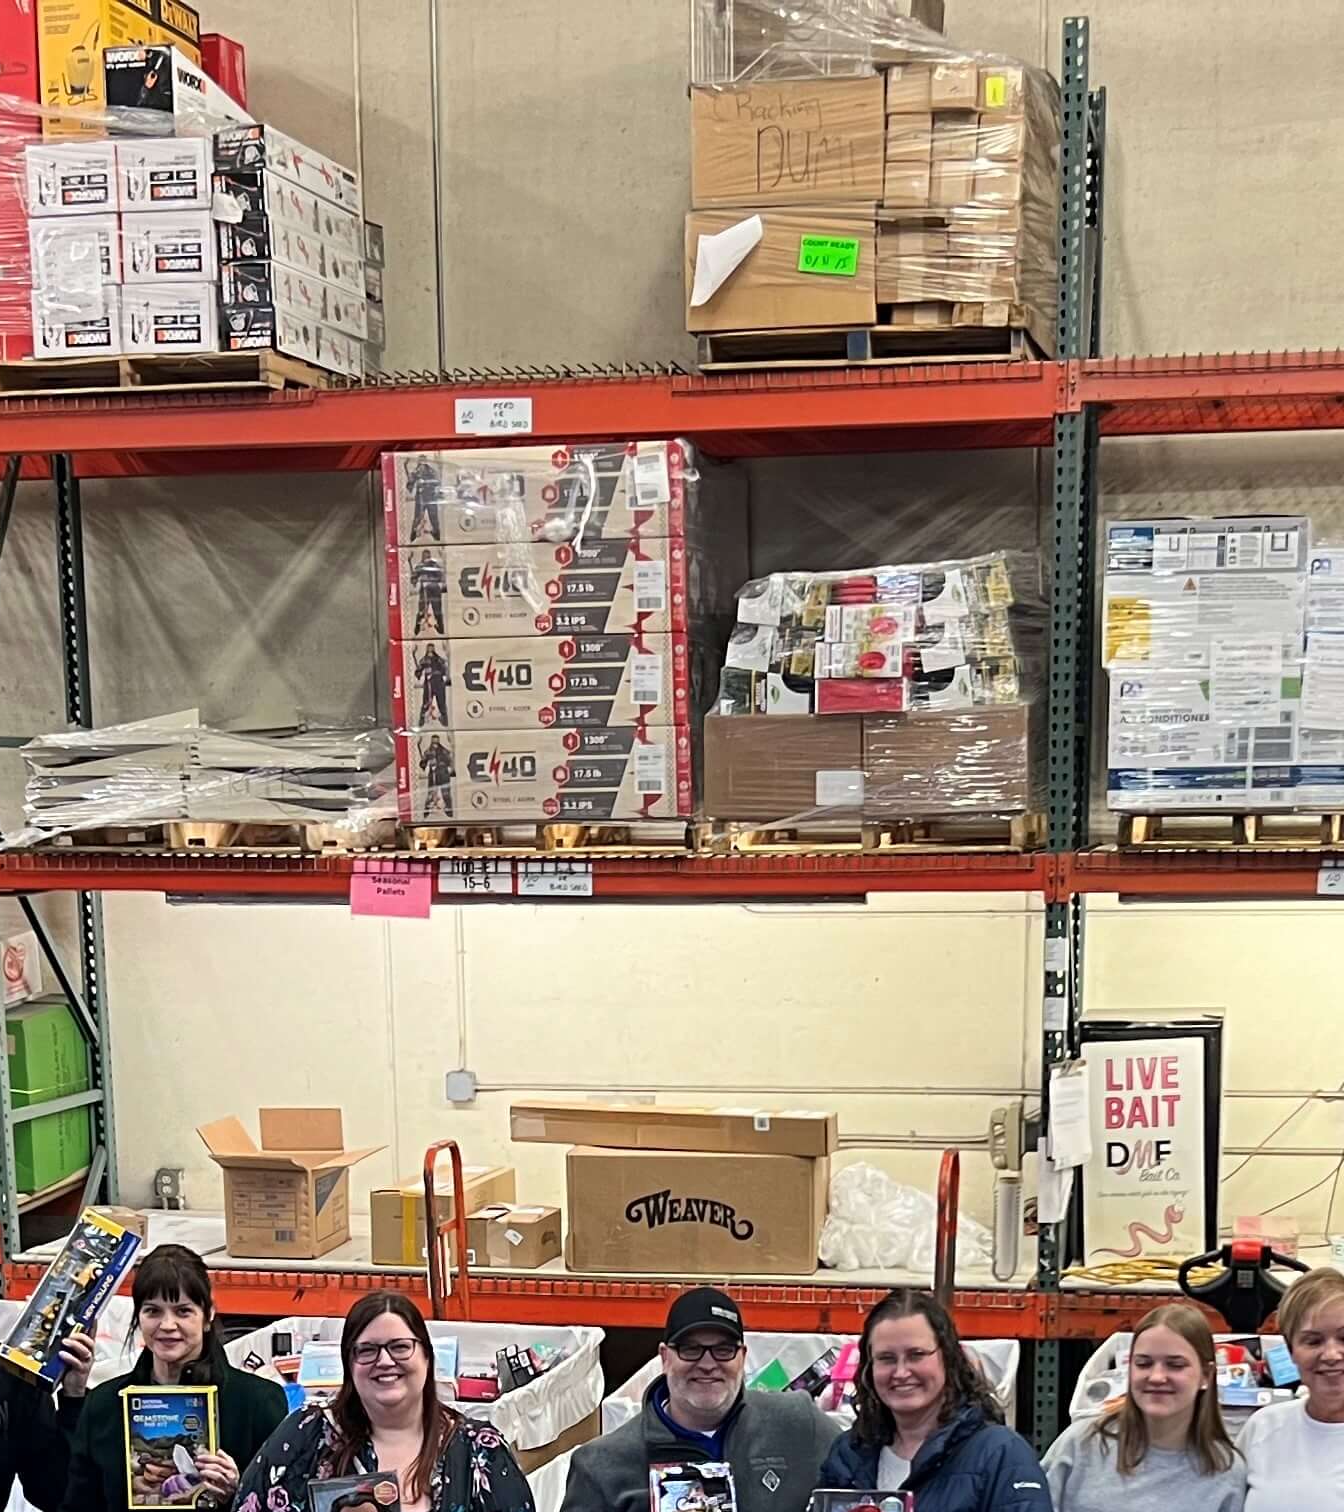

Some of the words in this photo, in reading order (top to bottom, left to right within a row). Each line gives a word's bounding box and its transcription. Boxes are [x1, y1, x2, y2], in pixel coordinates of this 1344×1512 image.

[177, 67, 202, 93] WORX
[372, 875, 411, 886] Seasonal
[463, 876, 491, 889] 15-6
[376, 886, 406, 896] Pallets
[1105, 1056, 1180, 1091] LIVE
[1104, 1095, 1181, 1129] BAIT
[626, 1189, 754, 1242] WEAVER
[133, 1414, 180, 1423] GEMSTONE
